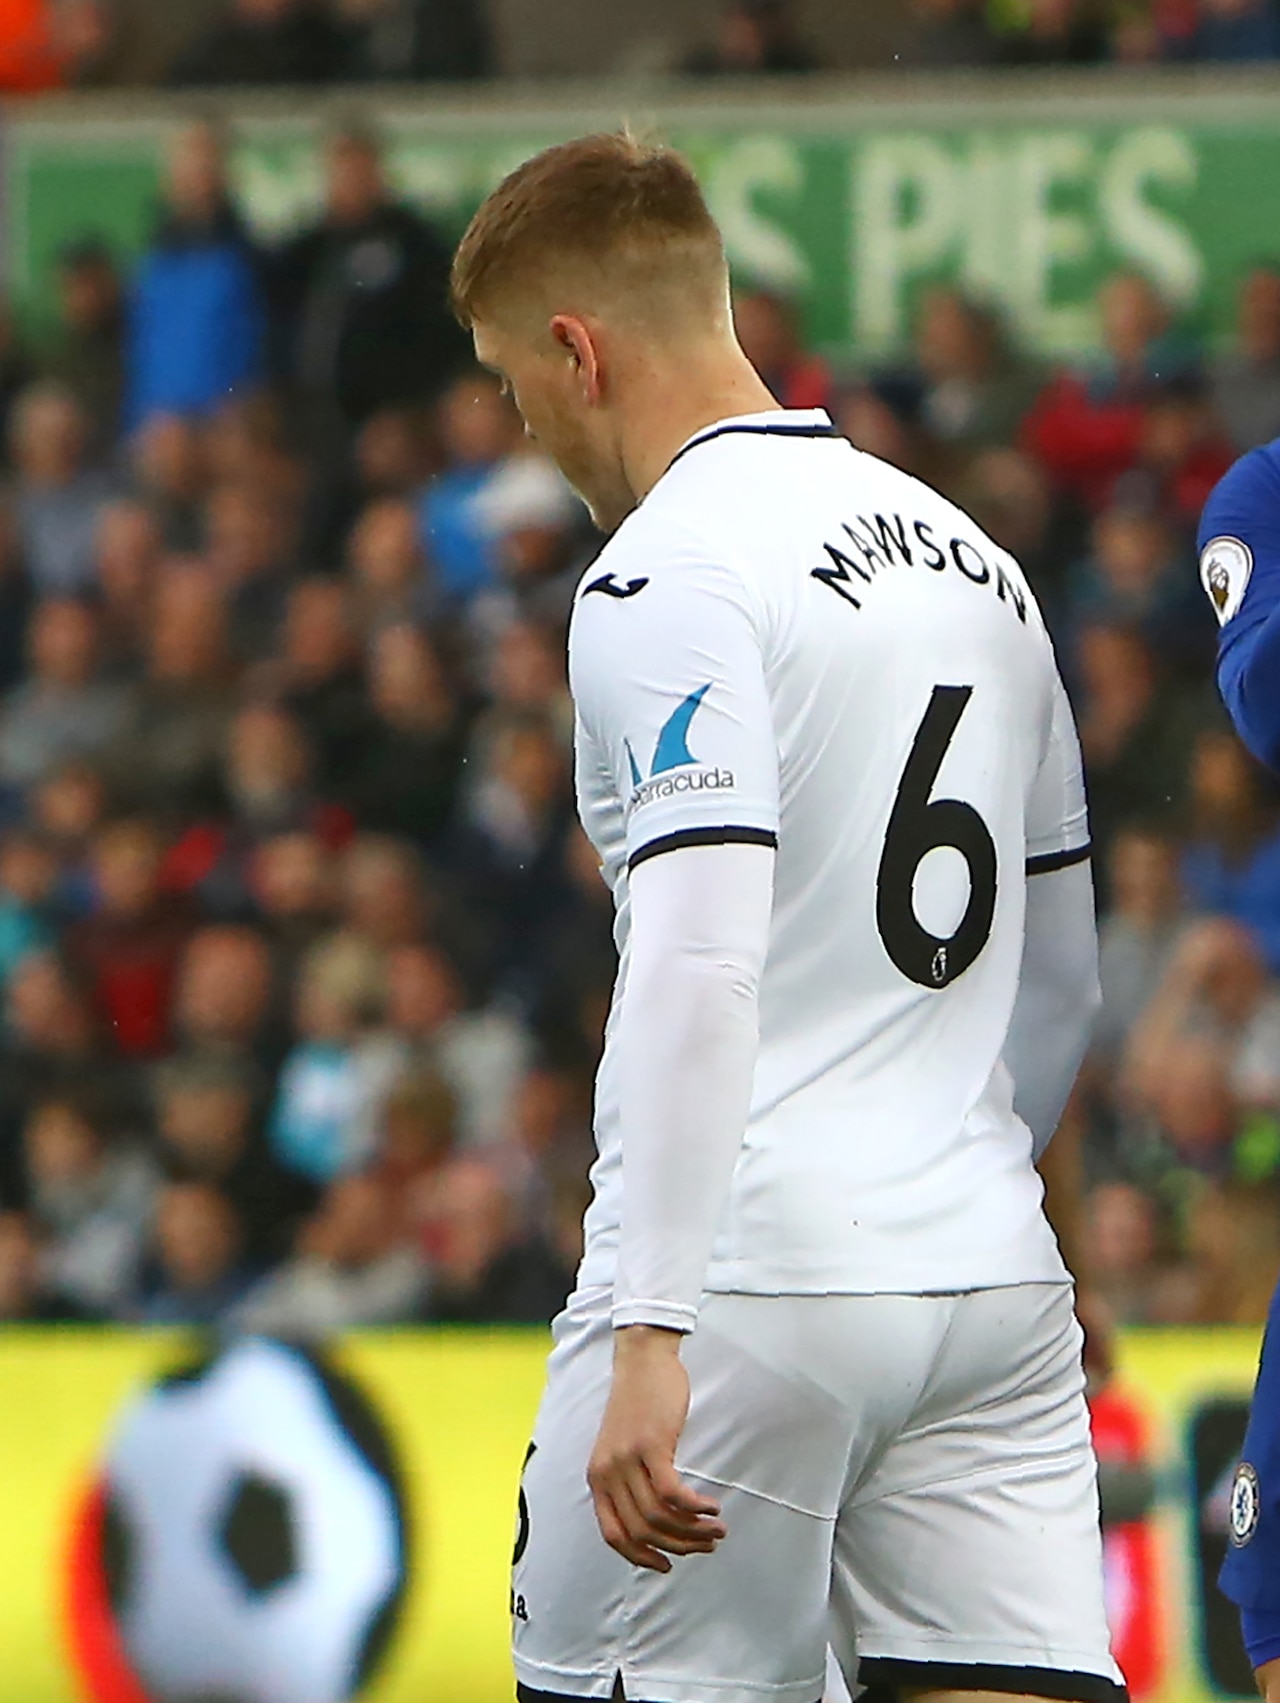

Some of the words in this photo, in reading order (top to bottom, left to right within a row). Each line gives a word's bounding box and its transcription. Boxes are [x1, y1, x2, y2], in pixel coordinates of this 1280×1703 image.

[850, 122, 1203, 358] PIES
[810, 512, 1027, 625] MAWSON
[876, 684, 998, 990] 6
